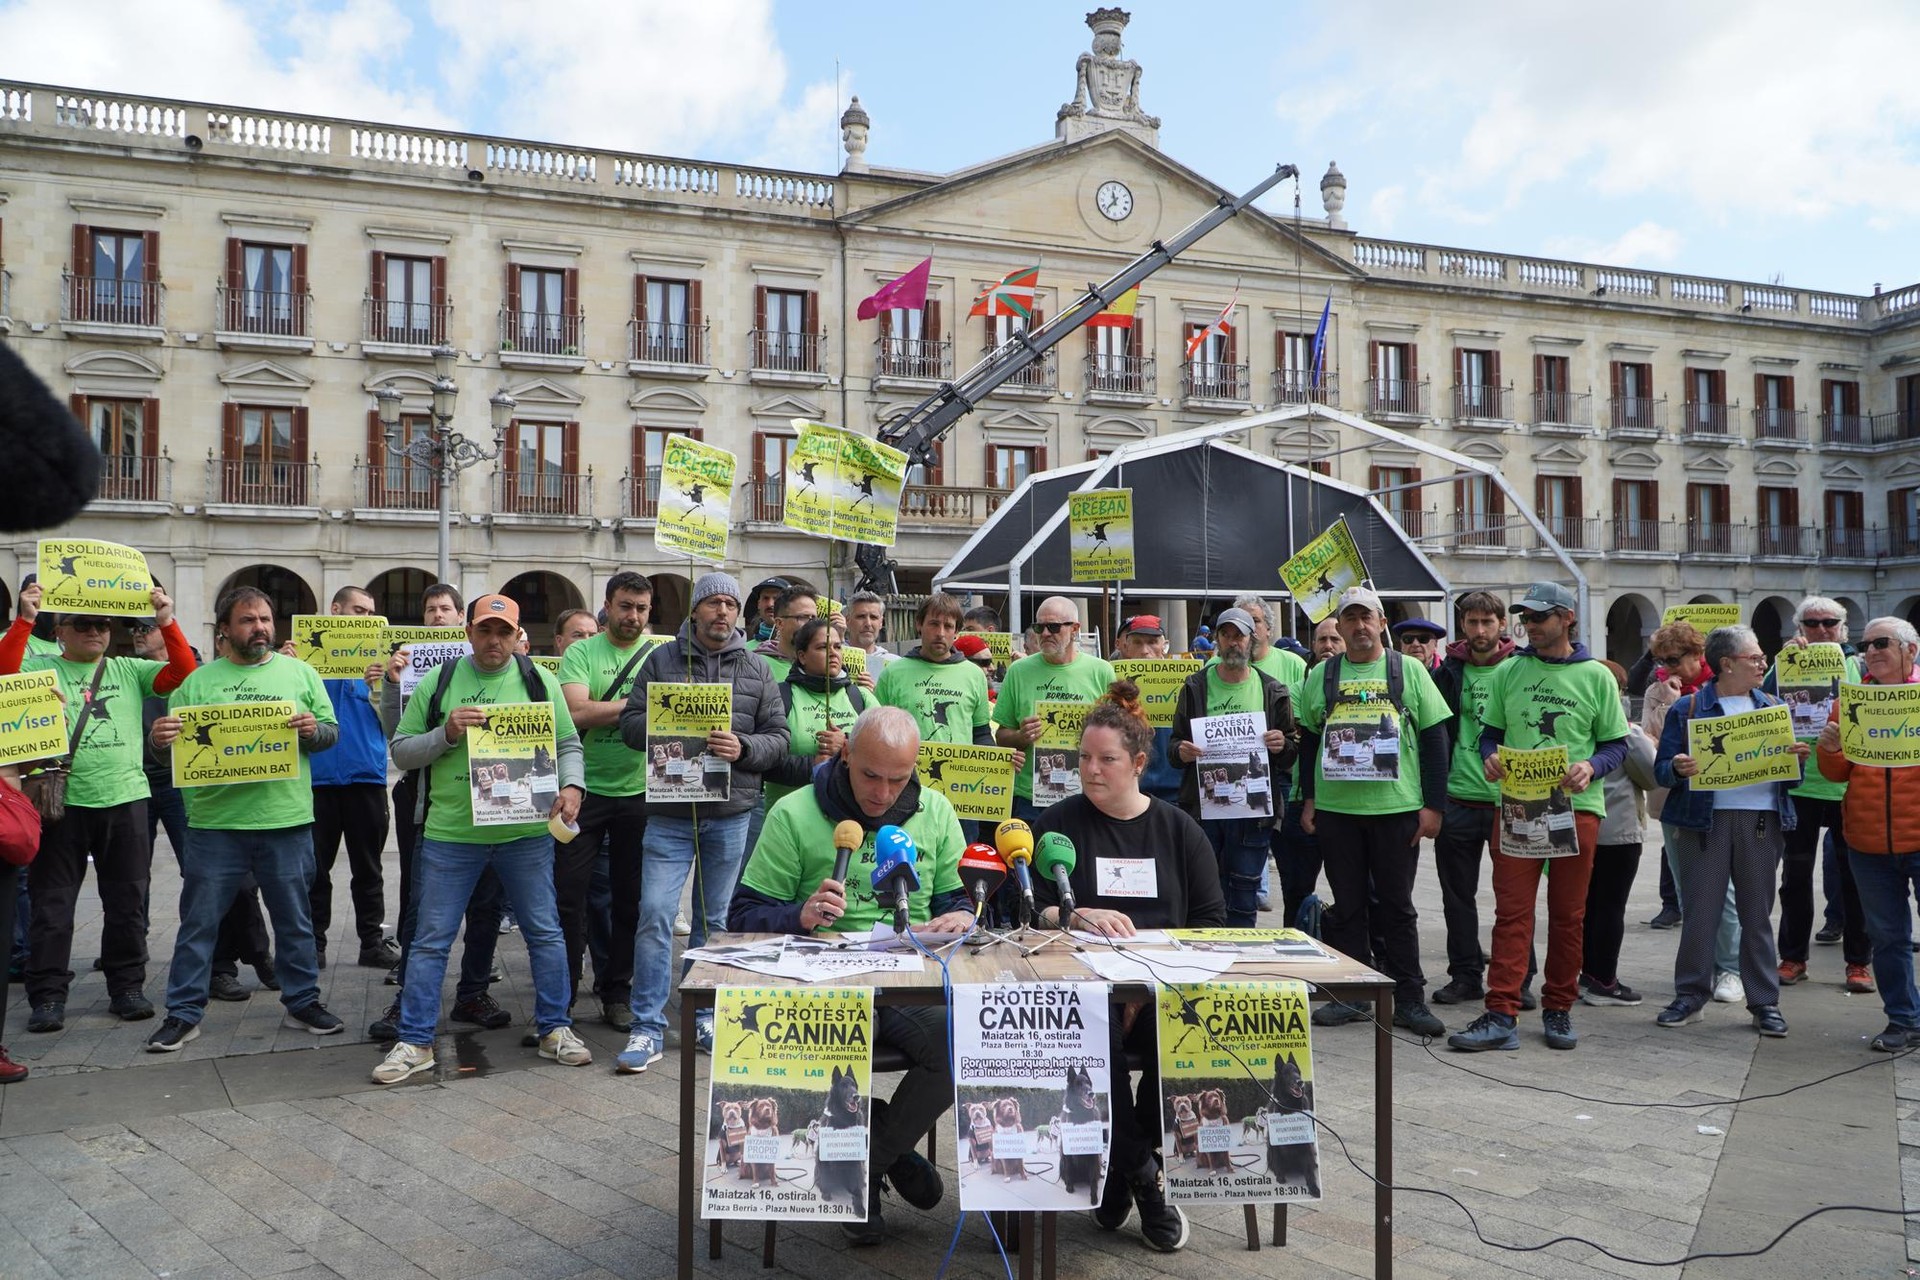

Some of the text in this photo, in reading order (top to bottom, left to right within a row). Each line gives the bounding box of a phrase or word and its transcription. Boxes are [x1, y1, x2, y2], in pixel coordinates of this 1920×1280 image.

[668, 449, 731, 480] GREBAN
[1072, 499, 1127, 519] GREBAN
[834, 511, 873, 525] Hemen lan
[659, 519, 690, 533] Hemen
[692, 524, 705, 538] lan
[833, 522, 857, 532] hemen
[45, 544, 145, 563] EN SOLIDARIDAD
[84, 560, 137, 571] HUELGUISTAS
[1073, 559, 1100, 567] Hemen
[1287, 540, 1335, 586] GREBAN
[1073, 568, 1099, 576] hemen
[87, 572, 149, 591] enviser
[46, 597, 149, 611] LOREZAINEKIN BAT
[1679, 608, 1739, 616] SOLIDARIDAD
[298, 620, 386, 630] EN SOLIDARIDAD
[382, 631, 393, 640] EN
[395, 630, 466, 640] SOLIDARIDAD
[331, 641, 377, 657] envise
[413, 648, 465, 657] PROTESTA
[1114, 663, 1201, 673] EN SOLIDARIDAD
[1800, 659, 1843, 669] CANINA
[223, 678, 257, 693] enviser
[915, 675, 943, 688] enviser
[1036, 677, 1064, 691] enviser
[1523, 677, 1554, 693] enviser
[44, 693, 58, 702] DE
[461, 687, 496, 704] enviser
[924, 688, 963, 698] BORROKAN
[1045, 692, 1083, 701] BORROKAN
[1841, 687, 1850, 697] EN
[1213, 696, 1242, 711] enviser
[1532, 694, 1577, 709] BORROKAN
[179, 706, 292, 723] EN SOLIDARIDAD
[674, 704, 728, 715] CANINA
[500, 715, 552, 724] PROTESTA
[1205, 719, 1254, 729] PROTESTA
[1696, 711, 1788, 734] EN SOLIDARIDAD
[220, 723, 278, 734] HUELGUISTAS
[495, 722, 552, 736] CANINA
[1205, 726, 1256, 739] CANINA
[1731, 728, 1779, 742] HUELGUISTAS
[40, 738, 62, 751] BAT
[224, 733, 290, 756] enviser
[1735, 738, 1789, 763] enviser
[919, 746, 1013, 763] EN SOLIDARIDAD
[1845, 746, 1911, 760] LOREZAINEKIN
[950, 765, 998, 774] HUELGUISTAS
[1517, 758, 1566, 769] PROTESTA
[184, 763, 291, 780] LOREZAINEKIN BAT
[1514, 765, 1567, 780] CANINA
[1699, 765, 1792, 786] LOREZAINEKIN BAT
[951, 775, 1007, 796] enviser
[987, 806, 1005, 816] BAT
[877, 860, 894, 877] etb
[727, 990, 865, 1000] ELKARTASUN
[982, 991, 1081, 1006] PROTESTA
[777, 1001, 862, 1009] TXAKUR
[1213, 998, 1304, 1012] PROTESTA
[775, 1008, 868, 1022] PROTESTA
[979, 1006, 1085, 1030] CANINA
[1206, 1012, 1305, 1035] CANINA
[764, 1022, 867, 1046] CANINA
[982, 1031, 1081, 1041] Maiatzak 16, ostirala
[1266, 1033, 1306, 1041] PLANTILLA
[961, 1056, 1105, 1070] Por unos parques habitables
[1176, 1058, 1267, 1069] ELA ESK LAB
[729, 1066, 824, 1077] ELA ESK LAB
[961, 1067, 1066, 1079] para nuestros perros
[1201, 1135, 1231, 1143] PROPIO
[748, 1146, 778, 1154] PROPIO
[1171, 1176, 1272, 1188] Maiatzak 16, ostirala
[708, 1188, 816, 1202] Maiatzak 16, ostirala
[1171, 1191, 1192, 1199] Plaza
[1274, 1187, 1298, 1196] 18:30
[708, 1203, 730, 1211] Plaza
[732, 1204, 757, 1212] Berria
[766, 1205, 787, 1213] Plaza
[818, 1204, 843, 1214] 18:30
